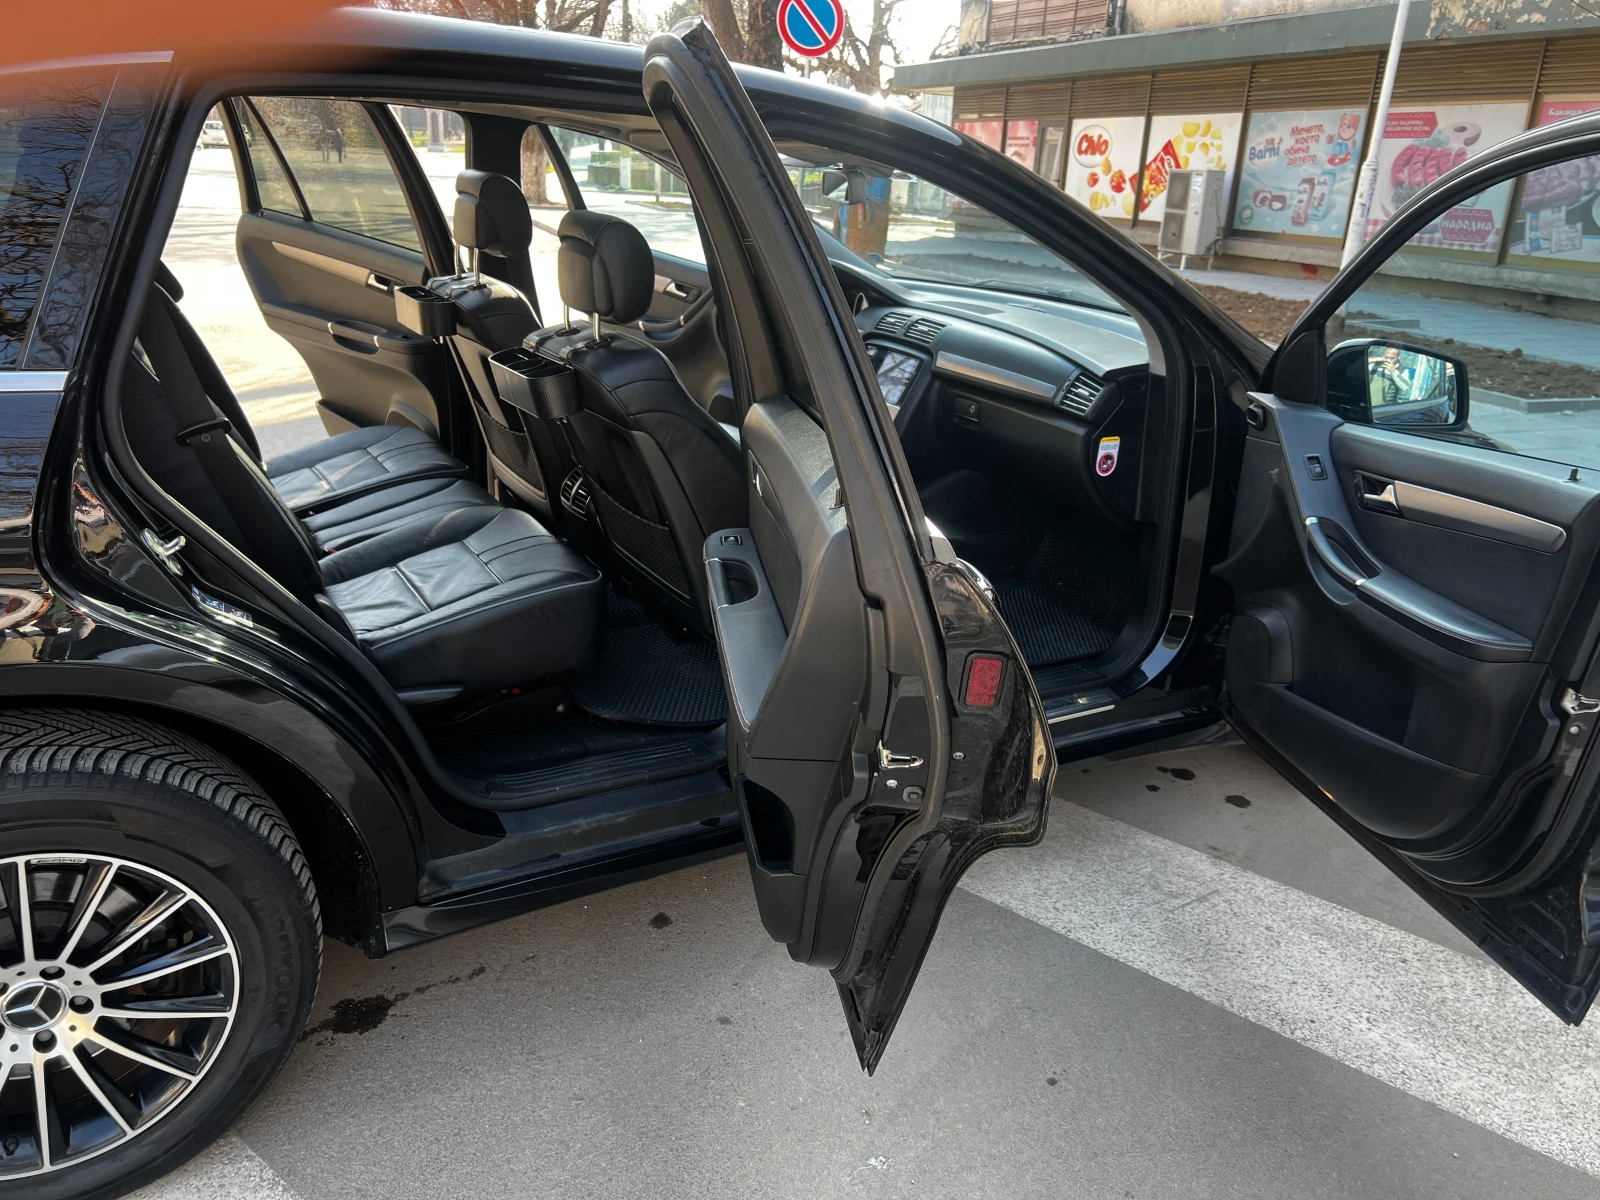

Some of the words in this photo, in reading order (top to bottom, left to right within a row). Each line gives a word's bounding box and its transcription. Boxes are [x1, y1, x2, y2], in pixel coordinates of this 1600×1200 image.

[1290, 124, 1325, 136] Мечето,
[1077, 133, 1109, 156] Chio
[1295, 134, 1321, 145] което
[1249, 142, 1281, 161] Barni
[1284, 145, 1311, 156] обича
[1286, 154, 1319, 167] детето.
[1441, 219, 1493, 232] народна
